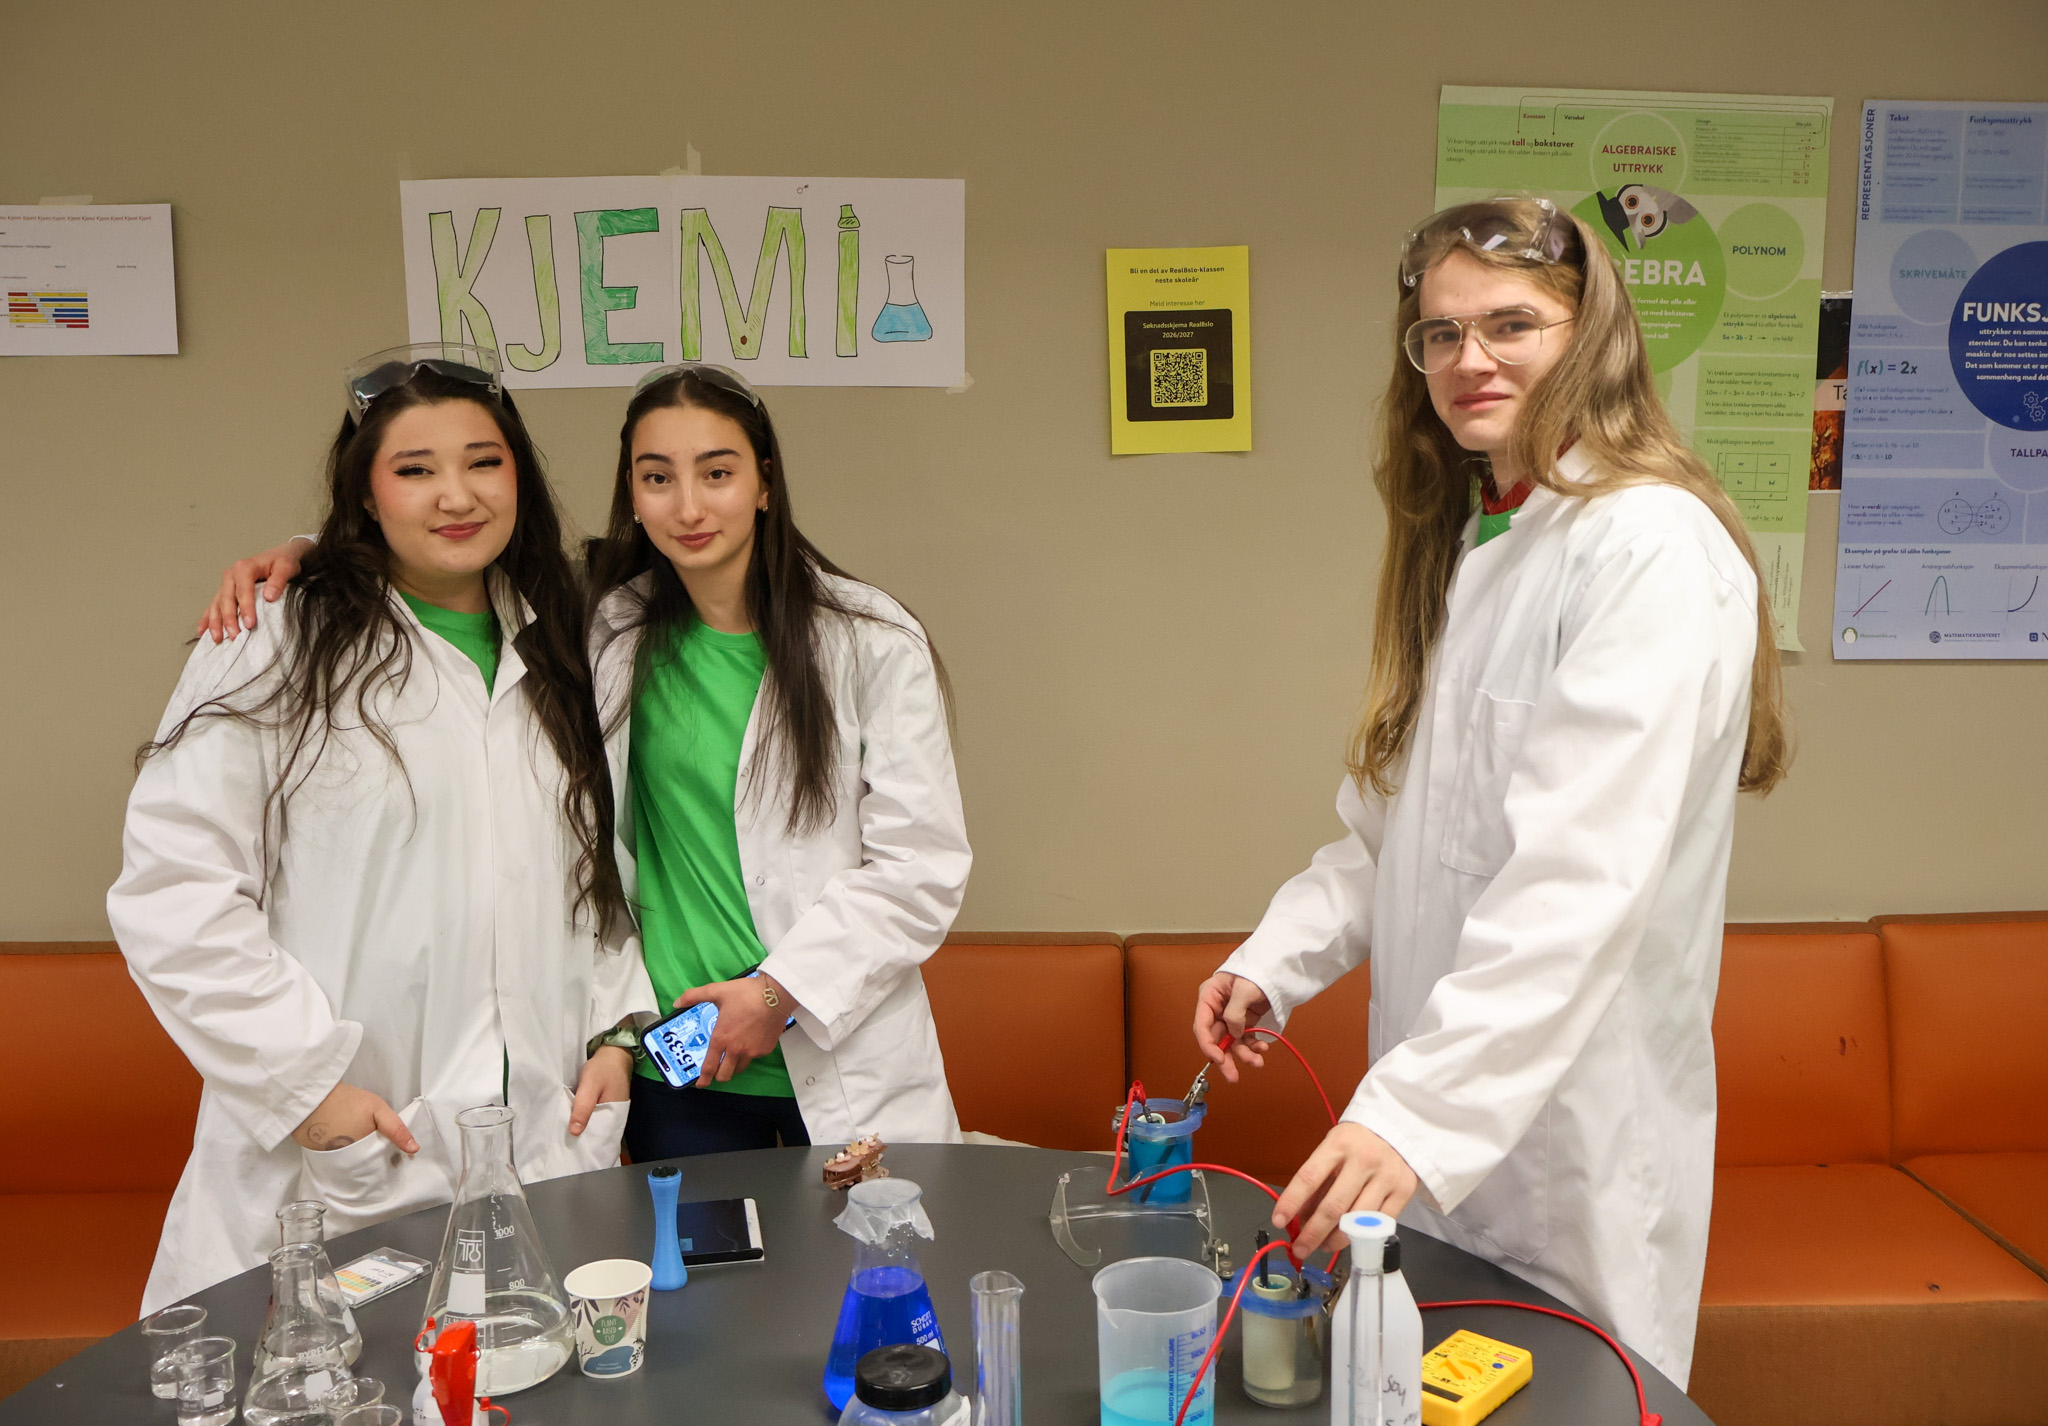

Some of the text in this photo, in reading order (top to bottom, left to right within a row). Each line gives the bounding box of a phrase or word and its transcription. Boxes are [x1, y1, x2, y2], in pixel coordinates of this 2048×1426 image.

[1534, 139, 1574, 148] bokstaver
[1602, 144, 1676, 156] ALGEBRAISKE
[1613, 163, 1663, 174] UTTRYKK
[1862, 108, 1876, 221] REPRESENTASJONER
[1732, 245, 1786, 256] POLYNOM
[1899, 268, 1968, 279] SKRIVEMÅTE
[429, 203, 859, 373] KJEMI
[1979, 327, 2011, 337] uttrykker
[1856, 360, 1884, 376] f(x)
[1900, 361, 1918, 374] 2x
[1976, 373, 2021, 382] sammenheng
[2011, 448, 2048, 458] TALLPA
[662, 1031, 698, 1072] 15:39
[494, 1225, 515, 1238] 1000
[509, 1278, 525, 1290] 800
[601, 1318, 617, 1327] PLANT
[911, 1310, 931, 1328] SCHOTT
[602, 1326, 617, 1335] BASED
[912, 1319, 932, 1334] DURAN
[605, 1334, 615, 1344] CUP
[916, 1334, 928, 1345] 500
[297, 1344, 327, 1362] PYREX
